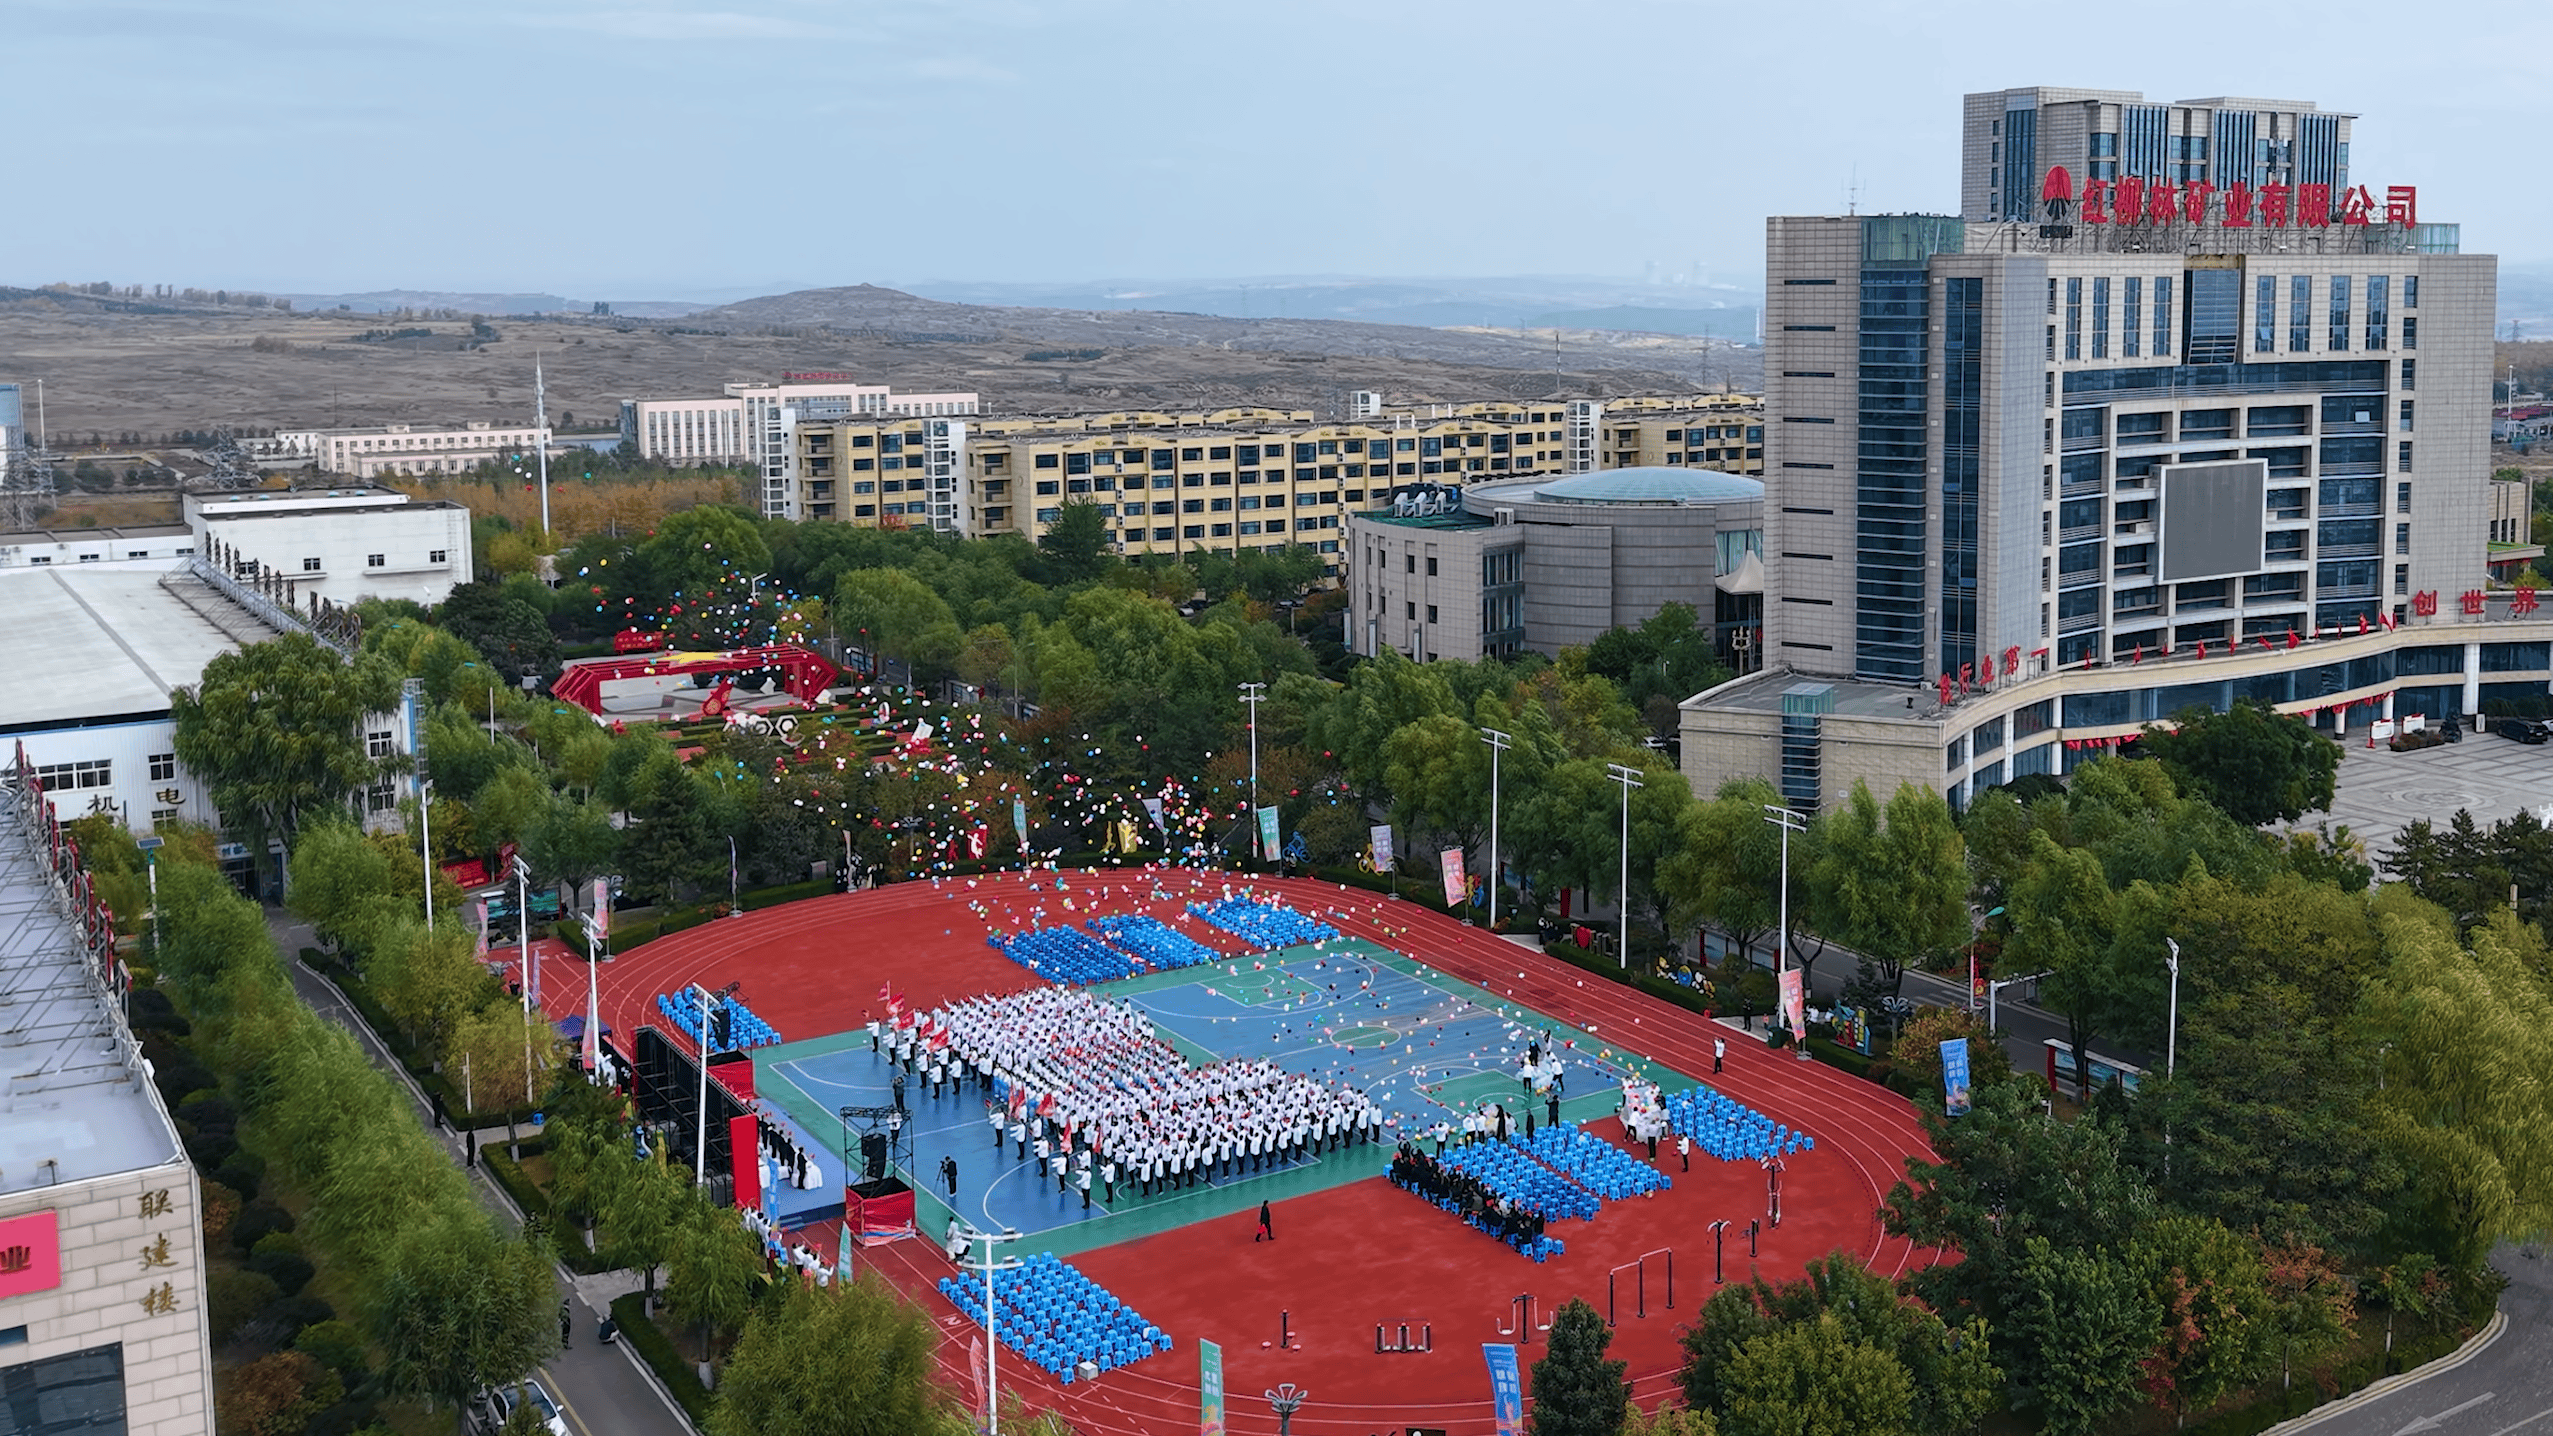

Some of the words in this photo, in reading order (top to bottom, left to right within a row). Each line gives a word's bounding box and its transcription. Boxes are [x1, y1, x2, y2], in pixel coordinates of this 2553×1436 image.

[2081, 176, 2416, 228] 红柳林矿业有限公司
[2411, 586, 2540, 616] 创世界
[137, 1188, 181, 1317] 联建楼
